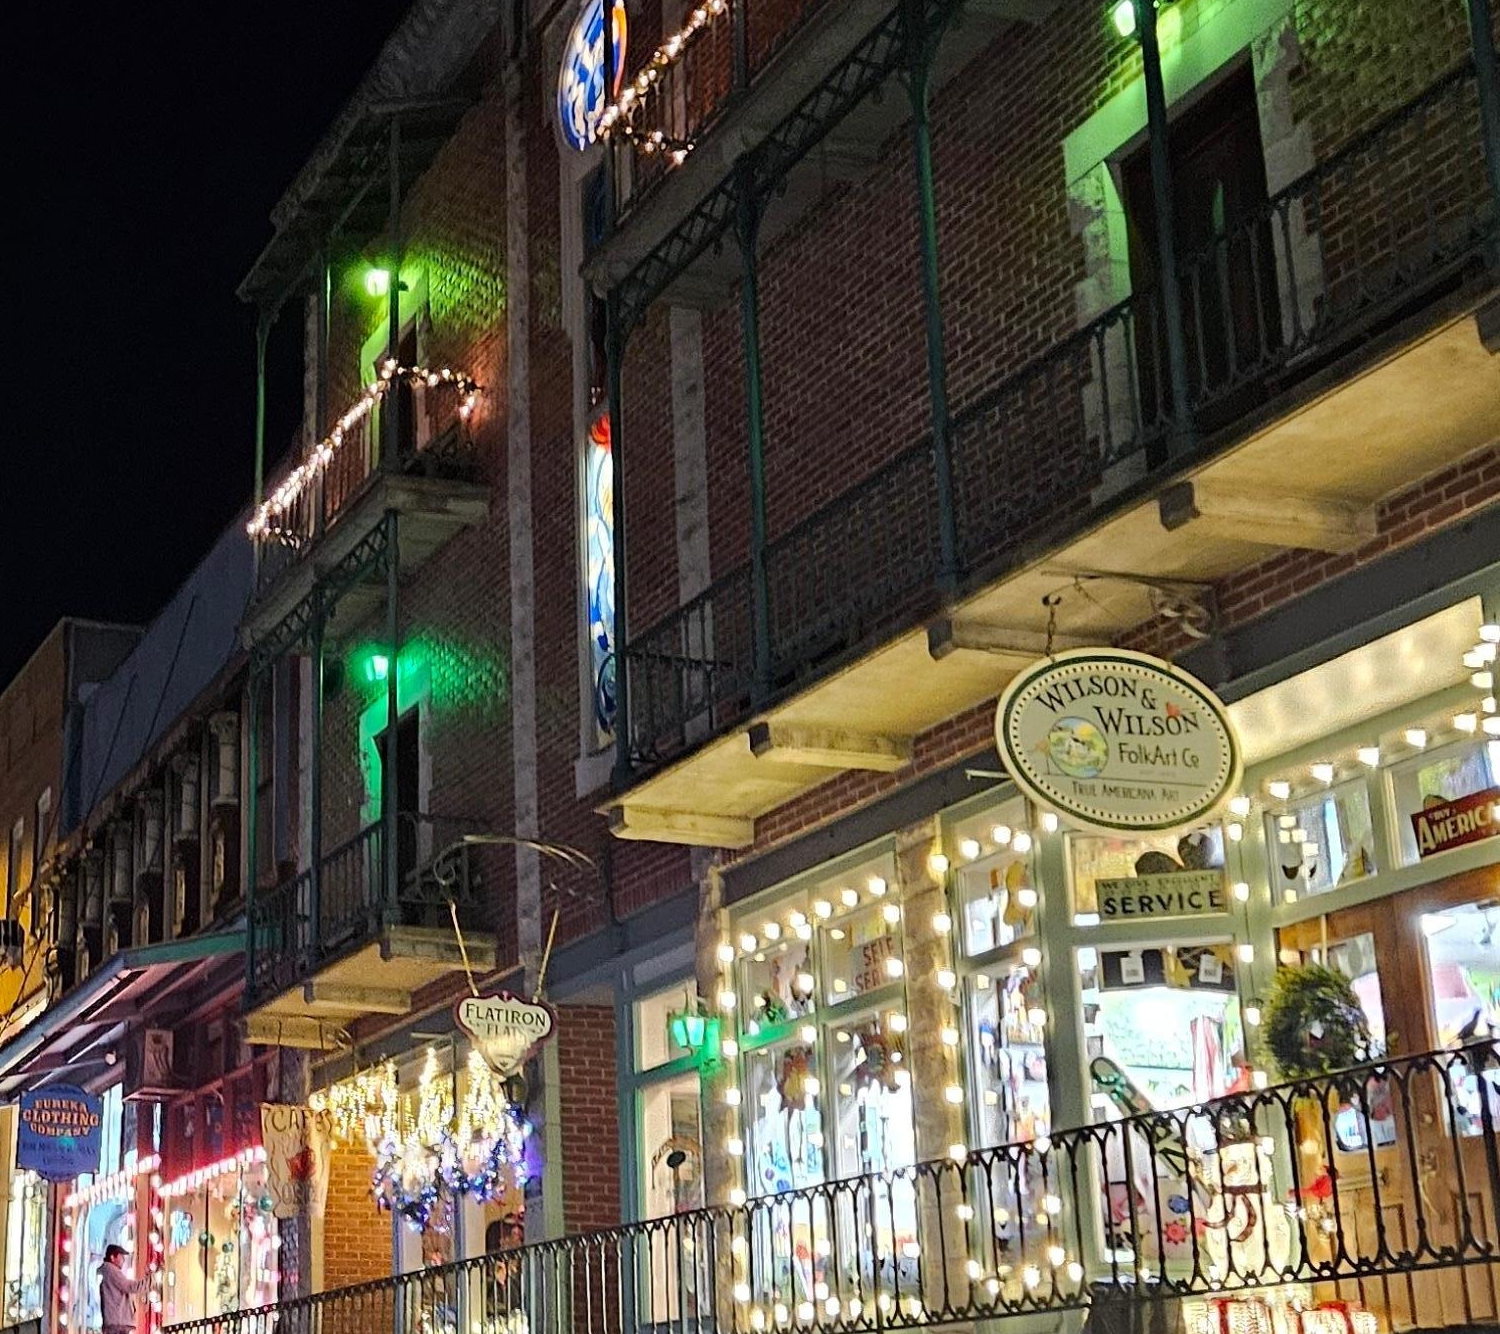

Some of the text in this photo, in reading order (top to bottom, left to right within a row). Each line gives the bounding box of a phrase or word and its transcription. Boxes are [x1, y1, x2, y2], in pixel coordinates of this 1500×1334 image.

[1035, 675, 1157, 714] WILSON &
[1093, 705, 1200, 736] WILSON
[1104, 890, 1224, 915] SERVICE
[466, 1002, 546, 1027] FLATIRON
[22, 1108, 99, 1126] CLOTHING
[34, 1099, 87, 1113] EUREKA
[30, 1123, 90, 1137] COMPANY
